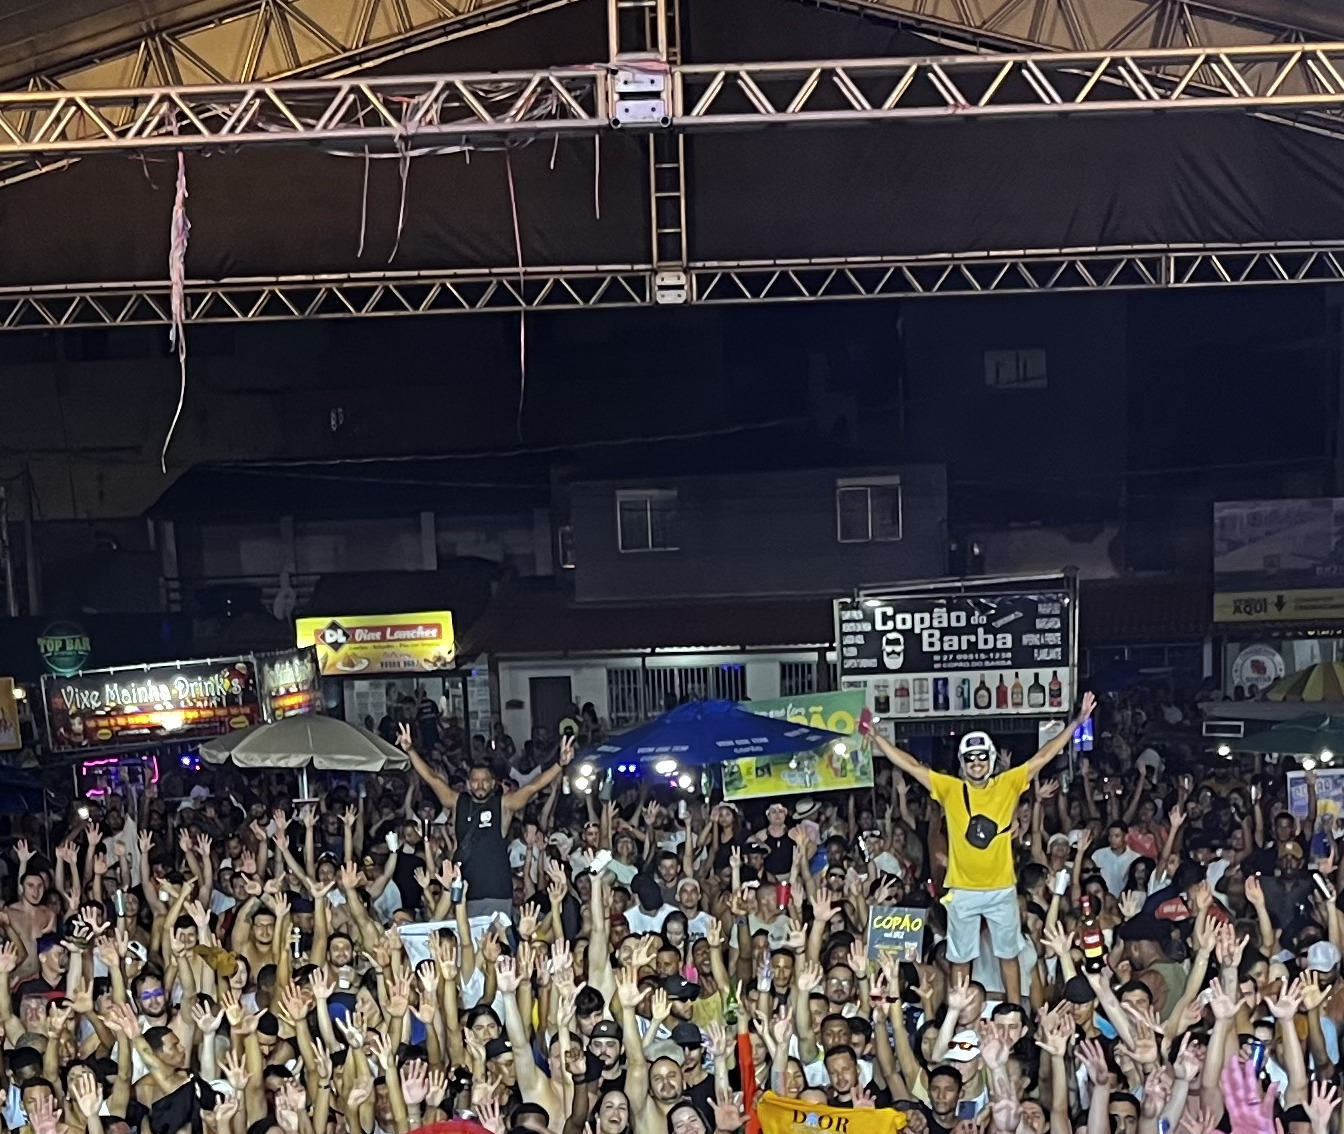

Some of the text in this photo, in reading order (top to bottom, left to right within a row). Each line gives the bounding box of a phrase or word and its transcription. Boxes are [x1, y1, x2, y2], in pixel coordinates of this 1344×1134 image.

[874, 606, 987, 633] Copão do
[37, 635, 91, 652] TOP BAR
[324, 628, 347, 644] DL
[922, 628, 1013, 652] Barba
[61, 686, 101, 710] Vixe
[105, 679, 171, 706] Mainha
